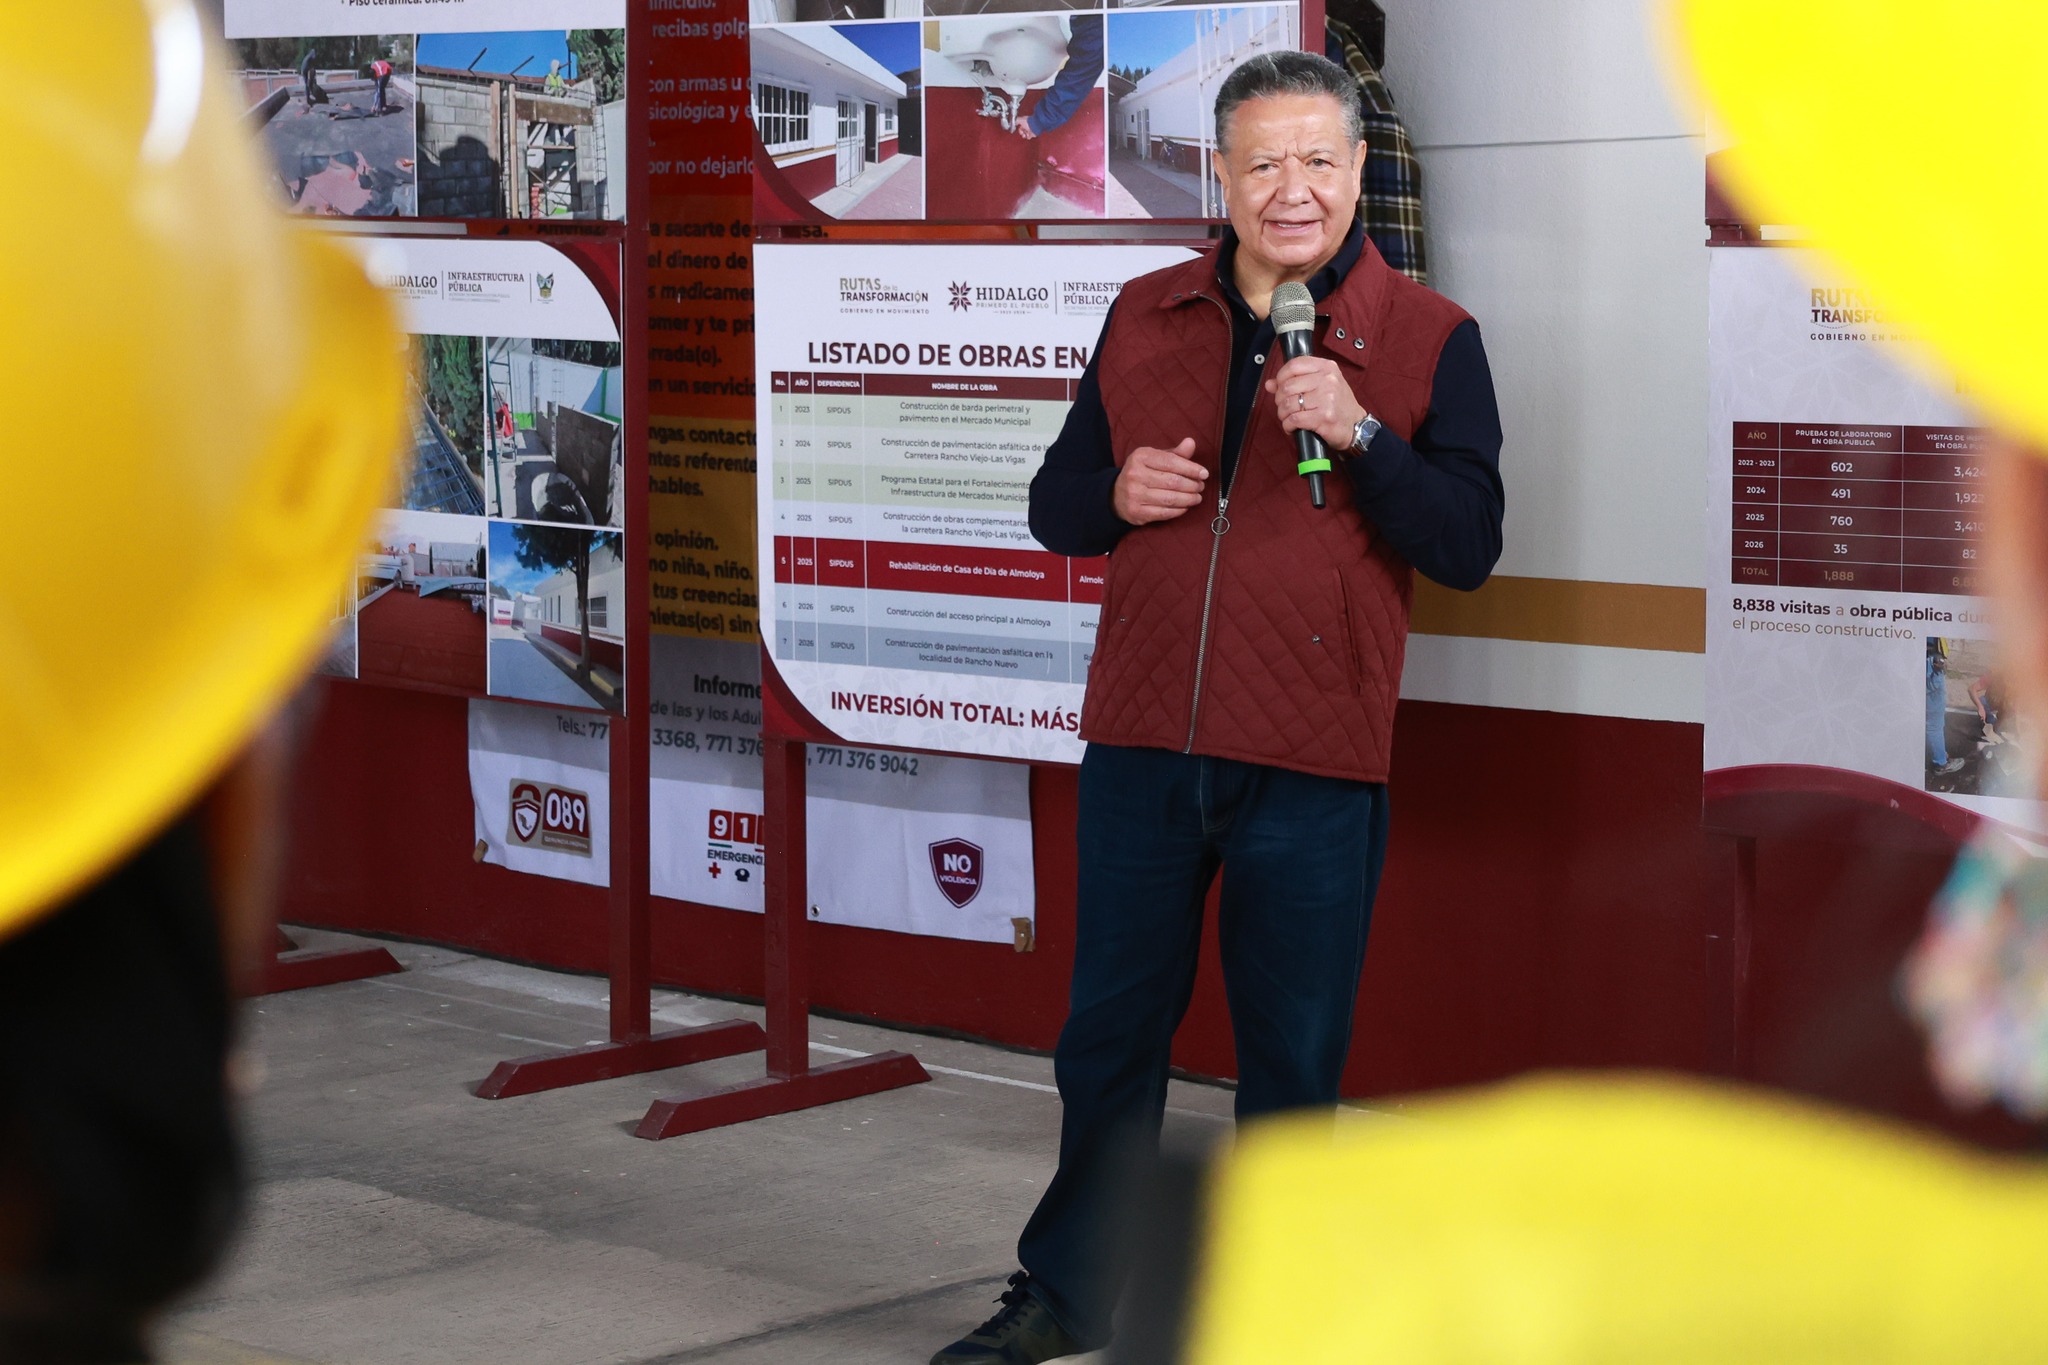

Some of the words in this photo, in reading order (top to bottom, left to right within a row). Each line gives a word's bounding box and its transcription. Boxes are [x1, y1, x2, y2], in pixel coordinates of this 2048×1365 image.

[652, 18, 708, 37] recibas
[679, 78, 726, 92] armas
[730, 105, 739, 123] y
[676, 160, 695, 174] no
[666, 222, 725, 237] sacarte
[730, 220, 751, 238] de
[666, 250, 720, 270] dinero
[726, 252, 747, 270] de
[448, 272, 524, 282] INFRAESTRUCTURA
[448, 281, 482, 293] PÚBLICA
[840, 278, 881, 291] RUTAS
[1063, 282, 1123, 292] INFRAESTR
[841, 291, 928, 303] TRANSFORMACIÓN
[977, 288, 1048, 301] HIDALGO
[1064, 293, 1109, 305] PÚBLICA
[695, 319, 704, 336] y
[709, 316, 726, 333] te
[809, 342, 910, 365] LISTADO
[919, 344, 950, 366] DE
[959, 344, 1046, 368] OBRAS
[1055, 346, 1087, 369] EN
[668, 380, 689, 393] un
[795, 378, 809, 387] AÑO
[817, 380, 860, 388] DEPENDENCIA
[932, 382, 958, 391] NOMBRE
[960, 383, 969, 391] DE
[980, 384, 998, 392] OBRA
[900, 402, 948, 411] Construcción
[950, 403, 960, 412] de
[961, 404, 983, 412] barda
[985, 405, 1024, 414] perimetral
[900, 415, 939, 423] pavimento
[952, 416, 958, 424] el
[961, 417, 992, 425] Mercado
[994, 417, 1031, 426] Municipal
[1748, 430, 1766, 440] AÑO
[1841, 431, 1891, 439] LABORATORIO
[1926, 434, 1953, 442] VISITAS
[881, 438, 929, 448] Construcción
[931, 440, 940, 448] de
[942, 440, 997, 450] pavimentación
[904, 452, 938, 461] Carretera
[941, 453, 968, 462] Rancho
[970, 454, 1003, 463] Viejo-Las
[1005, 456, 1025, 465] Vigas
[1831, 462, 1853, 473] 602
[881, 475, 917, 485] Programa
[919, 477, 943, 485] Estatal
[945, 479, 961, 487] para
[963, 478, 970, 487] el
[891, 488, 945, 498] Infraestructura
[948, 490, 957, 499] de
[959, 492, 993, 501] Mercados
[996, 493, 1029, 503] Municipa
[1747, 486, 1766, 494] 2024
[1831, 489, 1850, 499] 491
[883, 512, 931, 522] Construcción
[933, 514, 942, 523] de
[944, 515, 964, 524] obras
[1830, 516, 1852, 526] 760
[655, 529, 719, 551] opinión.
[910, 527, 943, 535] carretera
[945, 527, 972, 537] Rancho
[974, 529, 1008, 539] Viejo-Las
[1010, 531, 1029, 541] Vigas
[1745, 541, 1763, 549] 2026
[1834, 544, 1848, 554] 35
[1962, 549, 1976, 560] 82
[797, 558, 813, 566] 2025
[672, 557, 710, 580] niña,
[714, 560, 753, 581] niño.
[889, 561, 941, 573] Rehabilitación
[943, 564, 952, 573] de
[954, 565, 971, 575] Casa
[973, 566, 982, 575] de
[998, 568, 1007, 577] de
[1010, 569, 1044, 580] Almoloya
[1742, 567, 1769, 576] TOTAL
[1824, 571, 1854, 582] 1,888
[653, 583, 677, 600] tus
[887, 607, 934, 618] Construcción
[937, 610, 947, 619] del
[949, 613, 974, 621] acceso
[976, 614, 1007, 625] principal
[1016, 617, 1051, 627] Almoloya
[1732, 599, 1775, 613] 8,838
[1780, 600, 1830, 616] visitas
[1836, 607, 1844, 616] a
[1850, 605, 1886, 618] obra
[1893, 605, 1952, 623] pública
[729, 615, 752, 634] sin
[1732, 617, 1745, 630] el
[1750, 621, 1810, 634] proceso
[1815, 622, 1916, 640] constructivo.
[885, 638, 933, 650] Construcción
[935, 642, 944, 651] de
[946, 643, 1000, 656] pavimentación
[1035, 651, 1044, 659] en
[919, 654, 952, 663] localidad
[954, 656, 963, 664] de
[965, 657, 992, 667] Rancho
[995, 660, 1018, 669] Nuevo
[650, 701, 668, 716] de
[673, 702, 692, 719] las
[696, 708, 704, 722] y
[709, 706, 728, 722] los
[831, 692, 944, 720] INVERSIÓN
[950, 702, 1024, 728] TOTAL:
[1031, 706, 1079, 733] MÁS
[653, 728, 700, 753] 3368,
[706, 734, 732, 753] 771
[817, 747, 842, 766] 771
[846, 750, 875, 771] 376
[880, 754, 918, 776] 9042
[546, 793, 585, 833] 089
[943, 853, 971, 873] NO
[940, 875, 977, 885] VIOLENCIA
